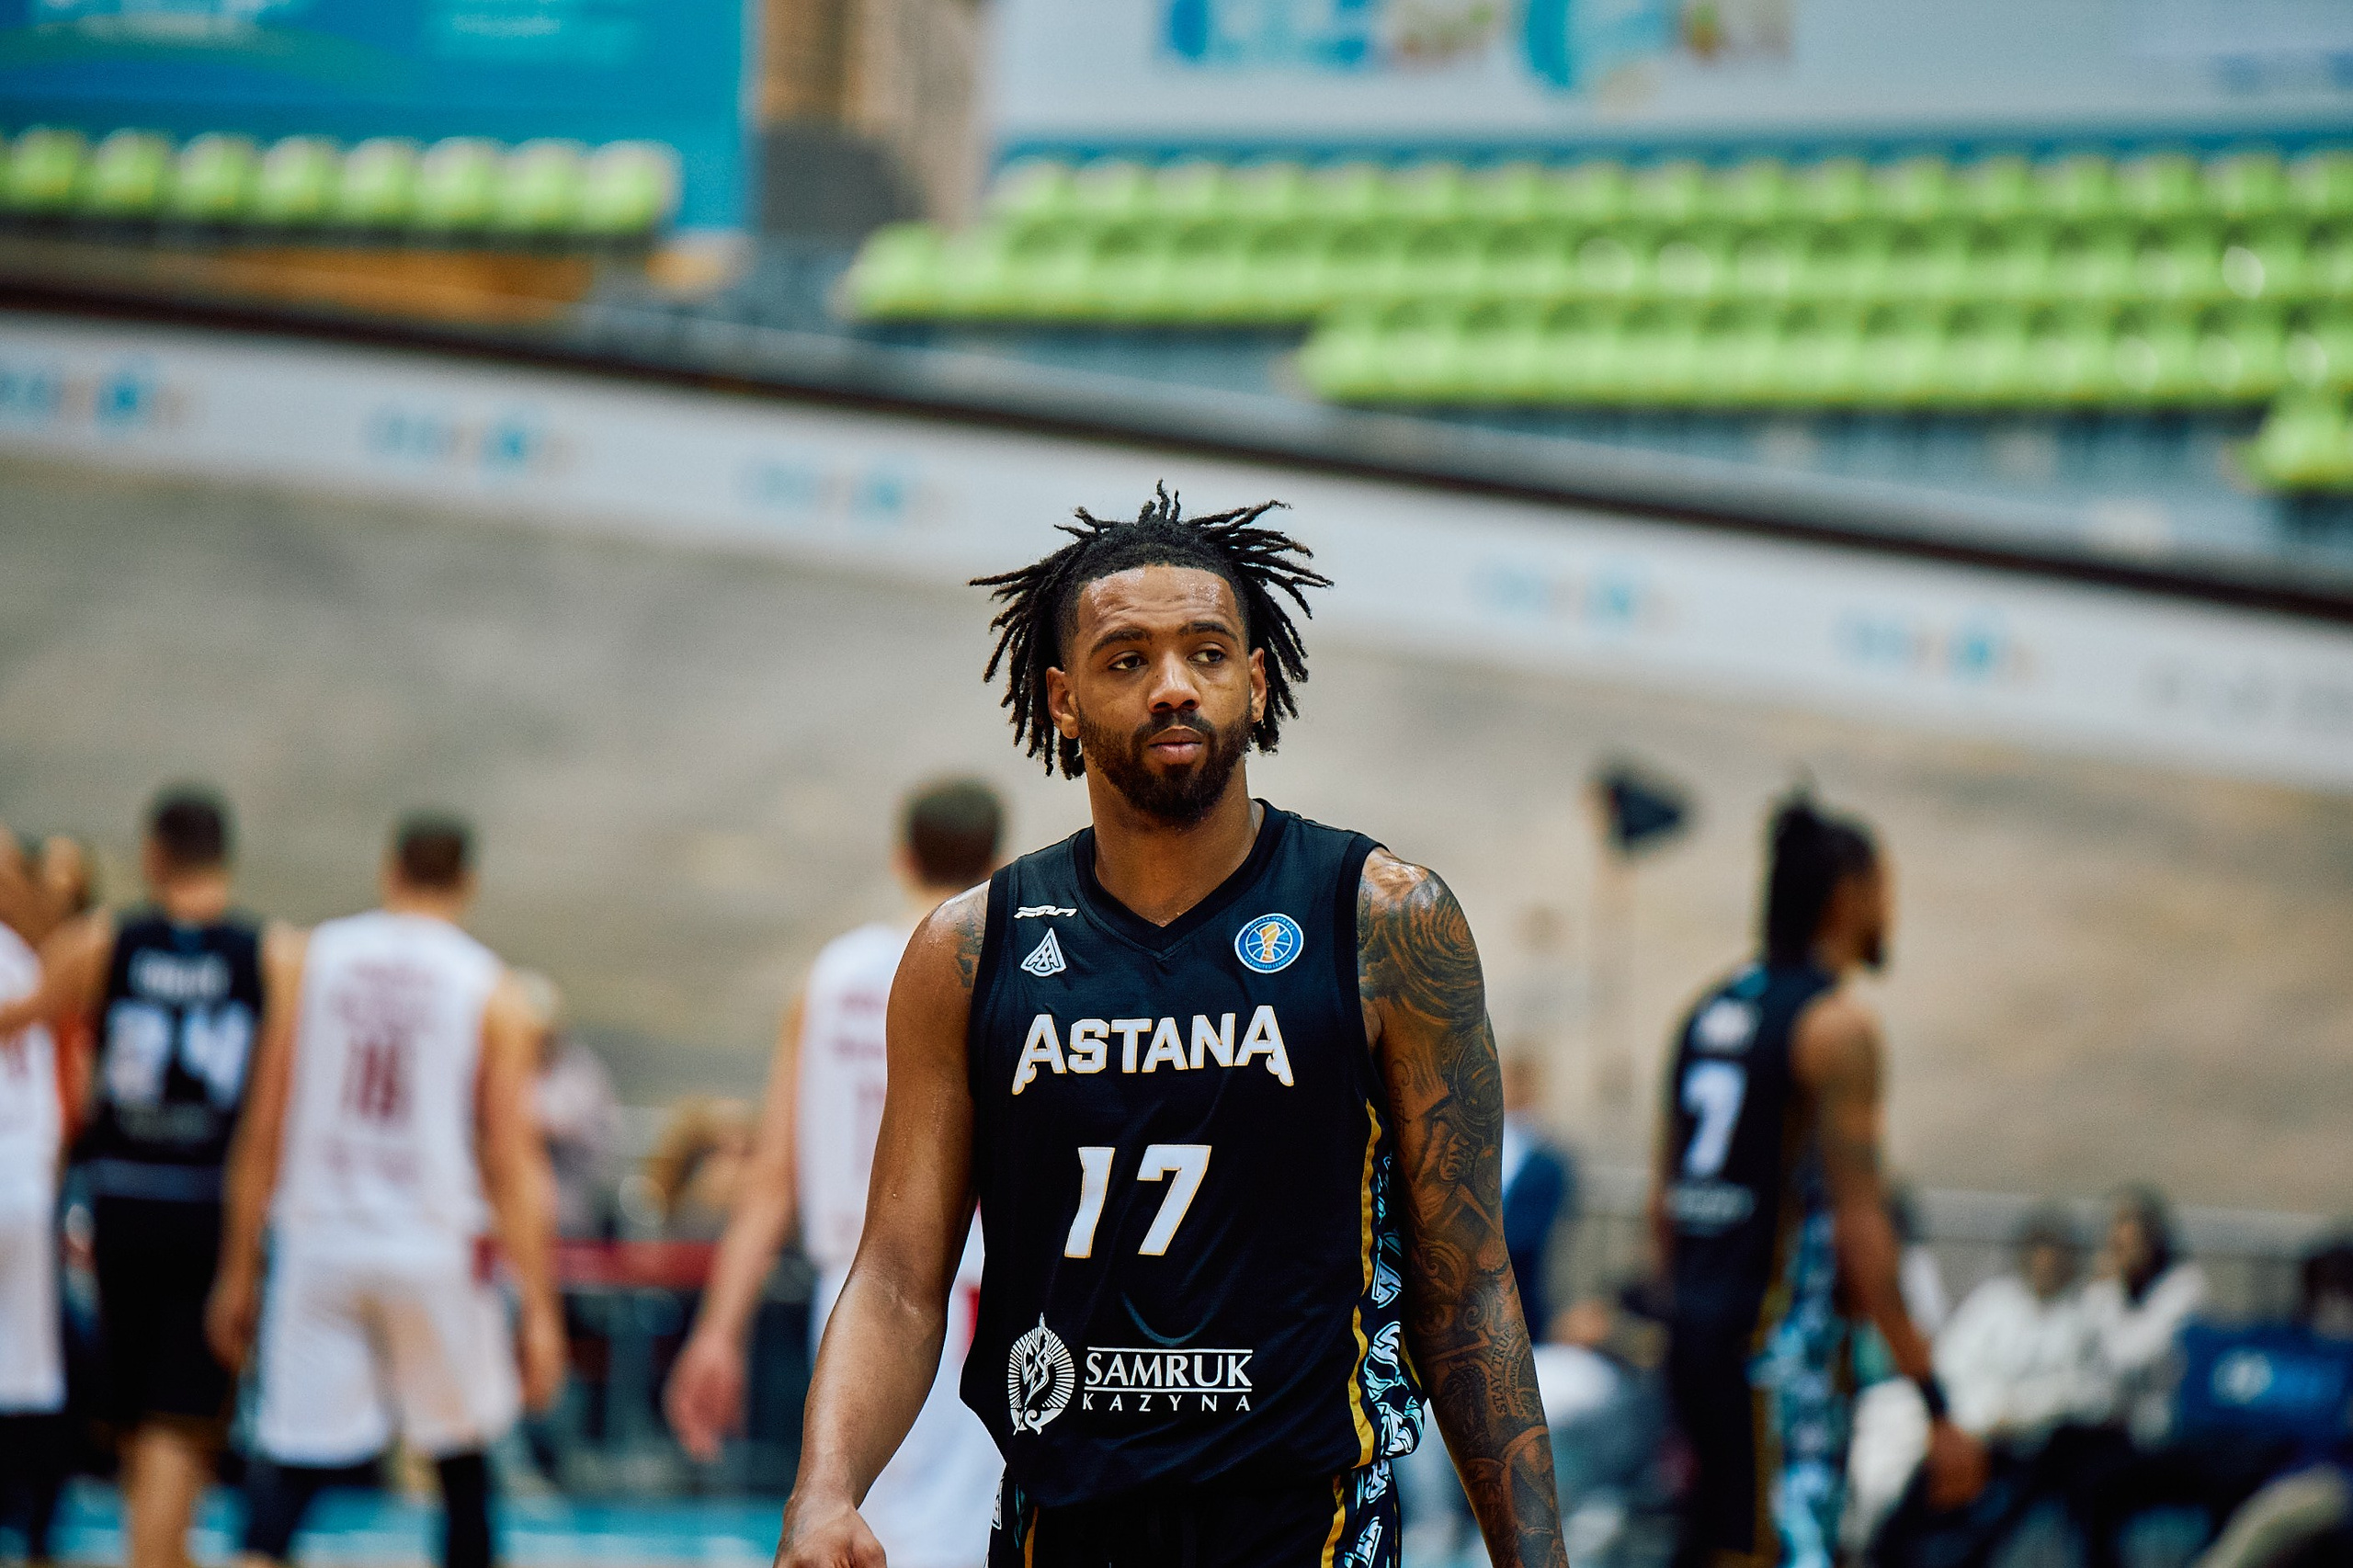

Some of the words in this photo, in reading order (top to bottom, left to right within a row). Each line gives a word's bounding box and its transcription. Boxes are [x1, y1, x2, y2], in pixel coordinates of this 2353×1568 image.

[1011, 1005, 1295, 1096] ASTANA
[1680, 1057, 1749, 1179] 7
[1063, 1143, 1212, 1259] 17
[1082, 1392, 1252, 1414] KAZYNA
[1085, 1348, 1254, 1389] SAMRUK
